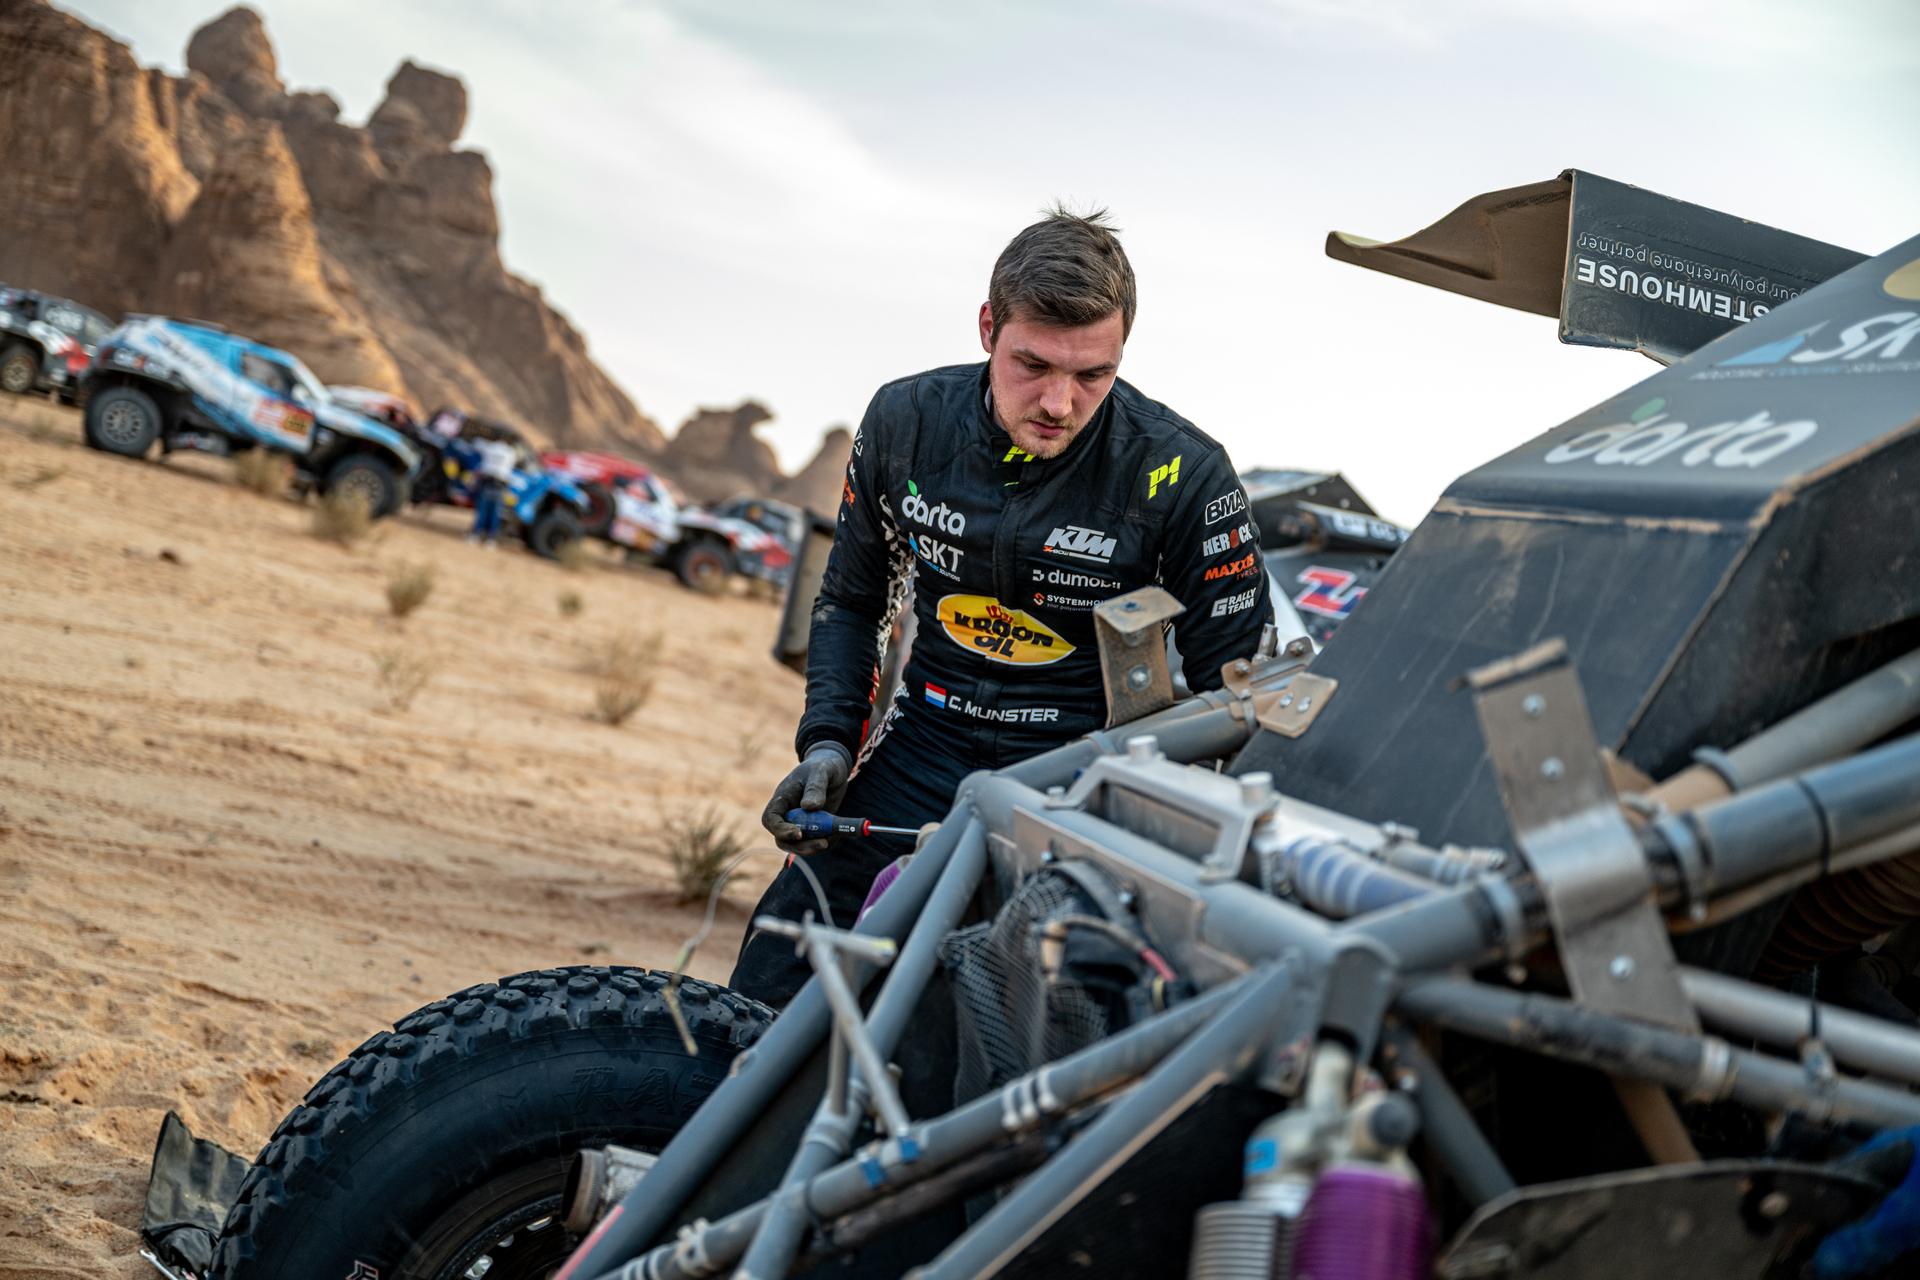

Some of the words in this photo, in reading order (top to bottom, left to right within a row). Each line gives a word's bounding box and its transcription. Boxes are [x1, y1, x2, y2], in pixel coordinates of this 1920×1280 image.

[1581, 235, 1646, 262] partner
[1577, 258, 1770, 323] STEMHOUSE
[1654, 255, 1766, 294] polyurethane
[1775, 287, 1799, 301] our
[1789, 311, 1920, 363] SK
[1545, 410, 1818, 468] darta
[1146, 455, 1182, 500] P1
[901, 493, 966, 537] darta
[1205, 489, 1246, 526] BMA
[918, 534, 965, 573] SKT
[1043, 525, 1118, 558] KTM
[1204, 553, 1255, 581] MAXXIS
[1047, 594, 1104, 608] SYSTEMHO
[1228, 587, 1257, 605] RALLY
[1228, 598, 1255, 615] TEAM
[954, 611, 1054, 647] KROON
[974, 635, 1016, 658] OIL
[948, 695, 962, 711] C.
[964, 700, 1060, 722] MUNSTER
